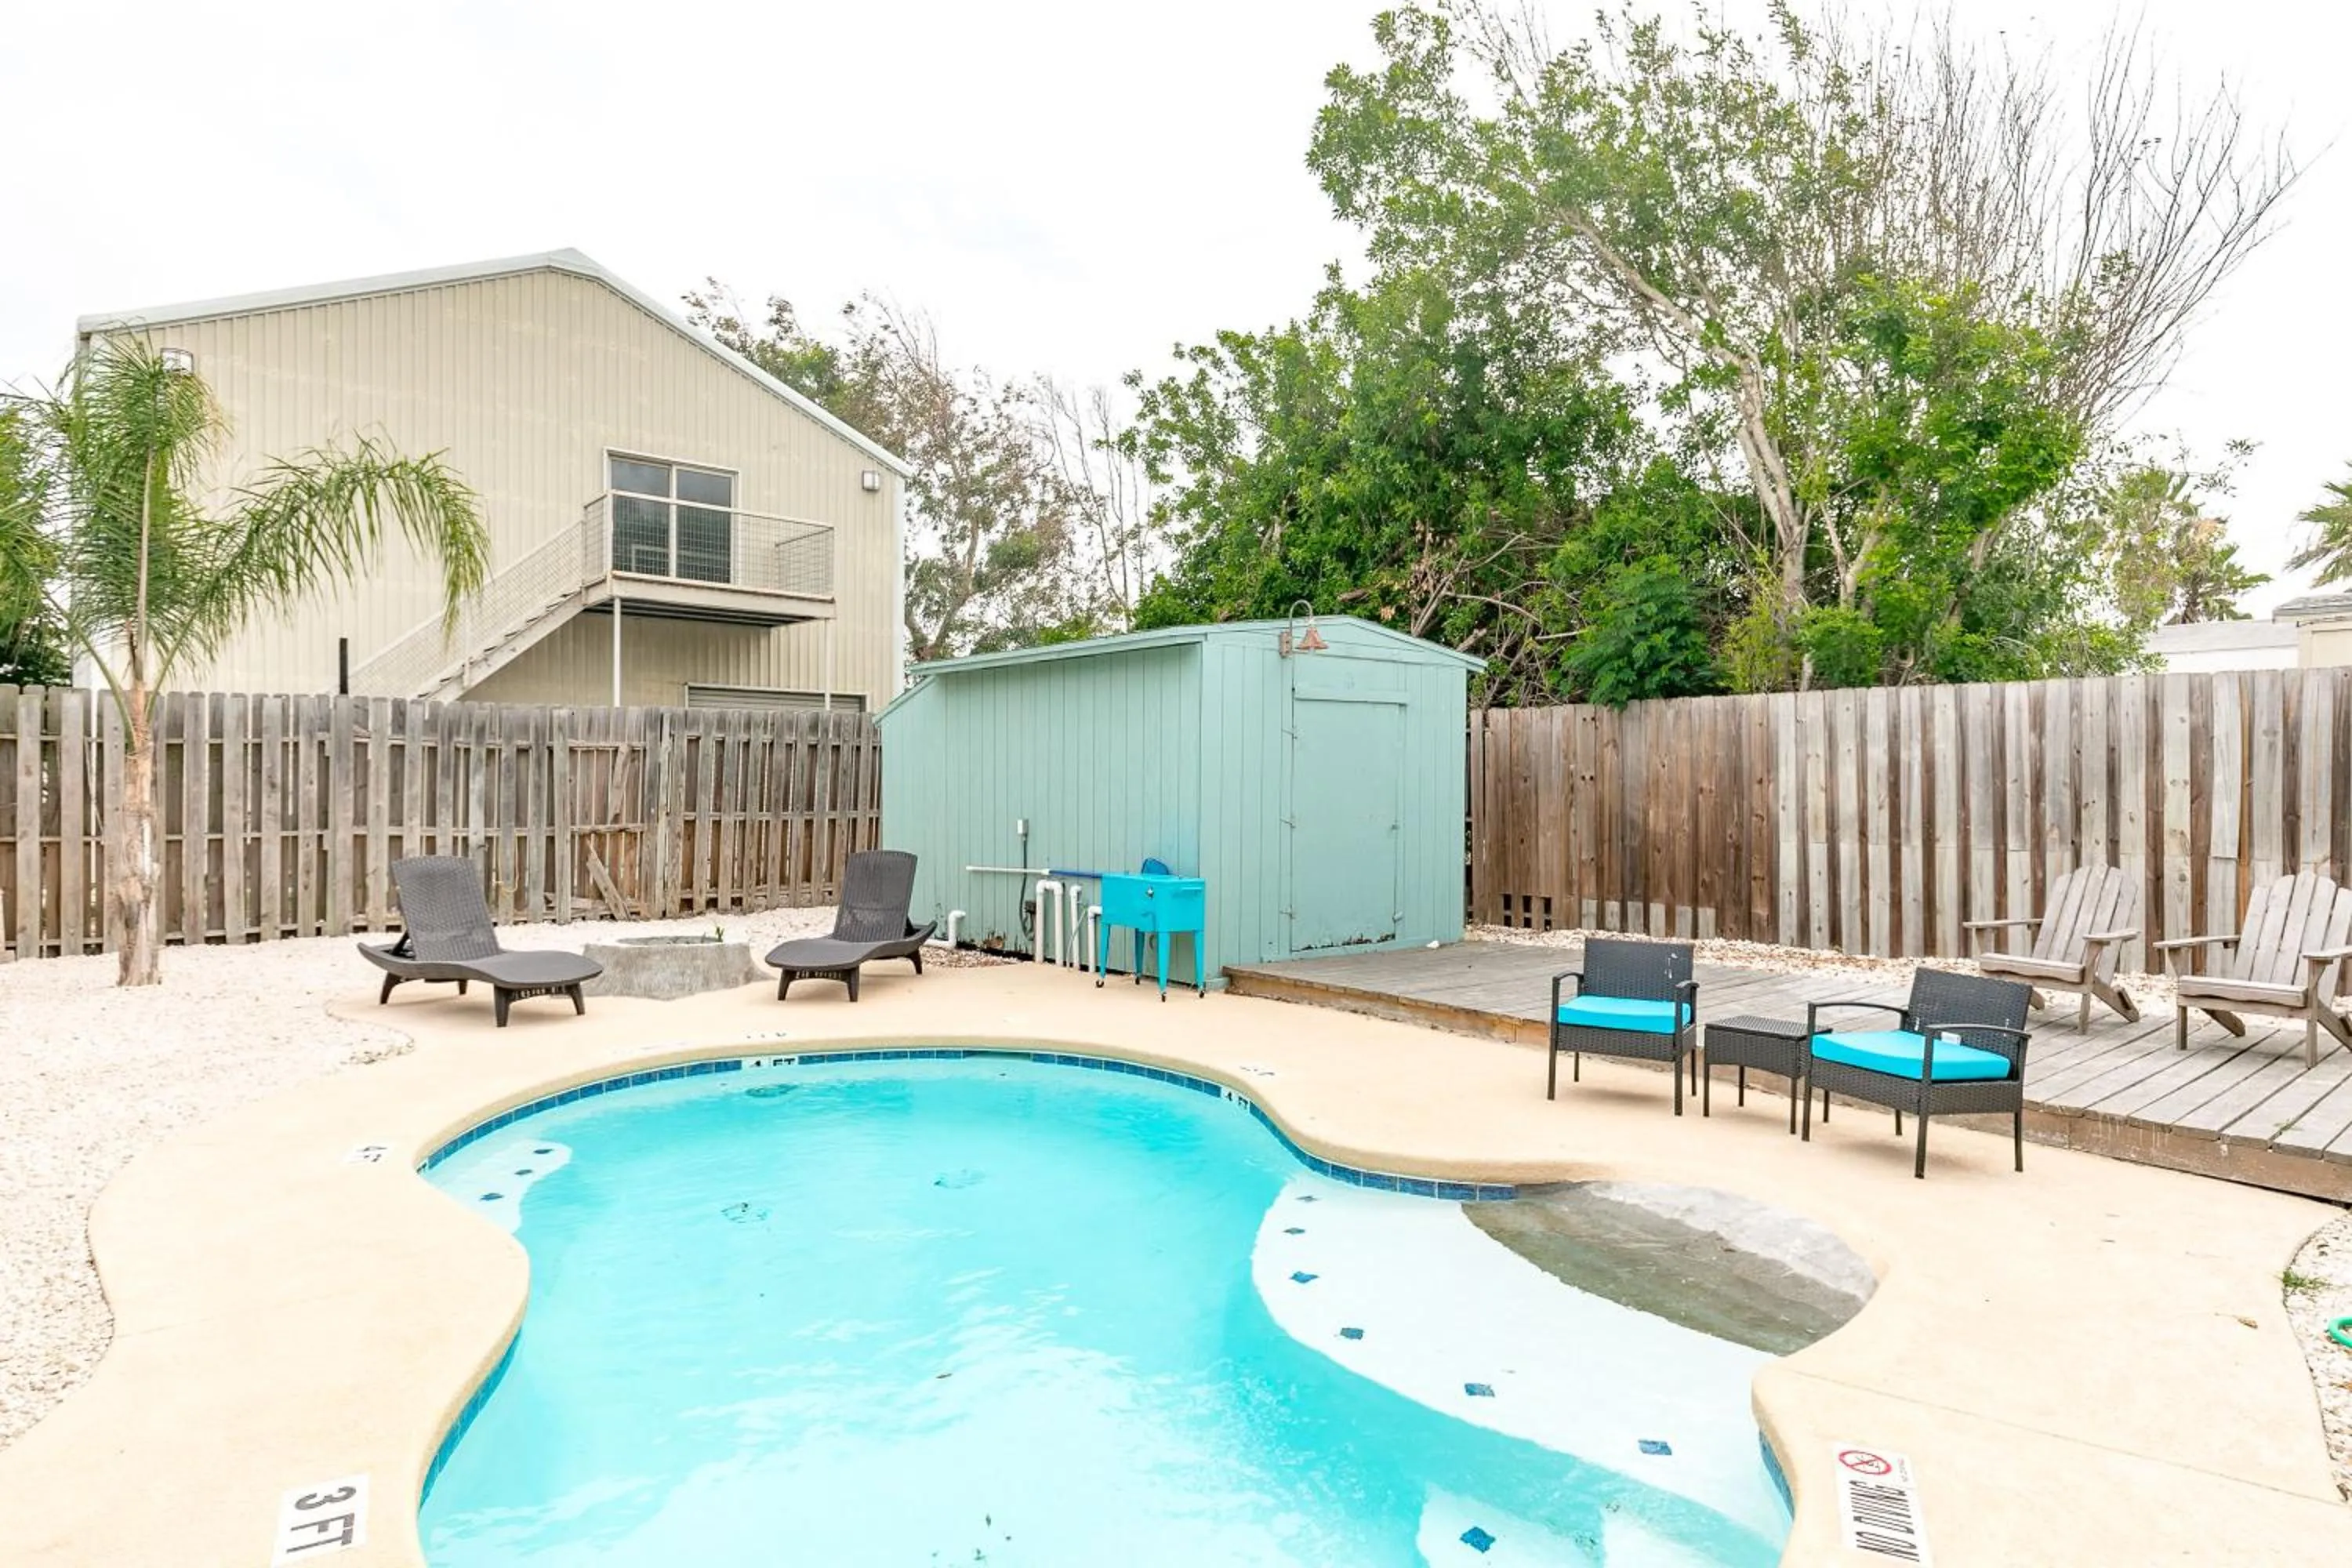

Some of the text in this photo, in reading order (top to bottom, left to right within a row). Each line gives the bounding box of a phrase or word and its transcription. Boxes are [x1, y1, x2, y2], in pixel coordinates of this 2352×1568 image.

[773, 1058, 796, 1067] FT
[285, 1486, 358, 1554] 3 FT
[1848, 1479, 1920, 1563] NO DIVING
